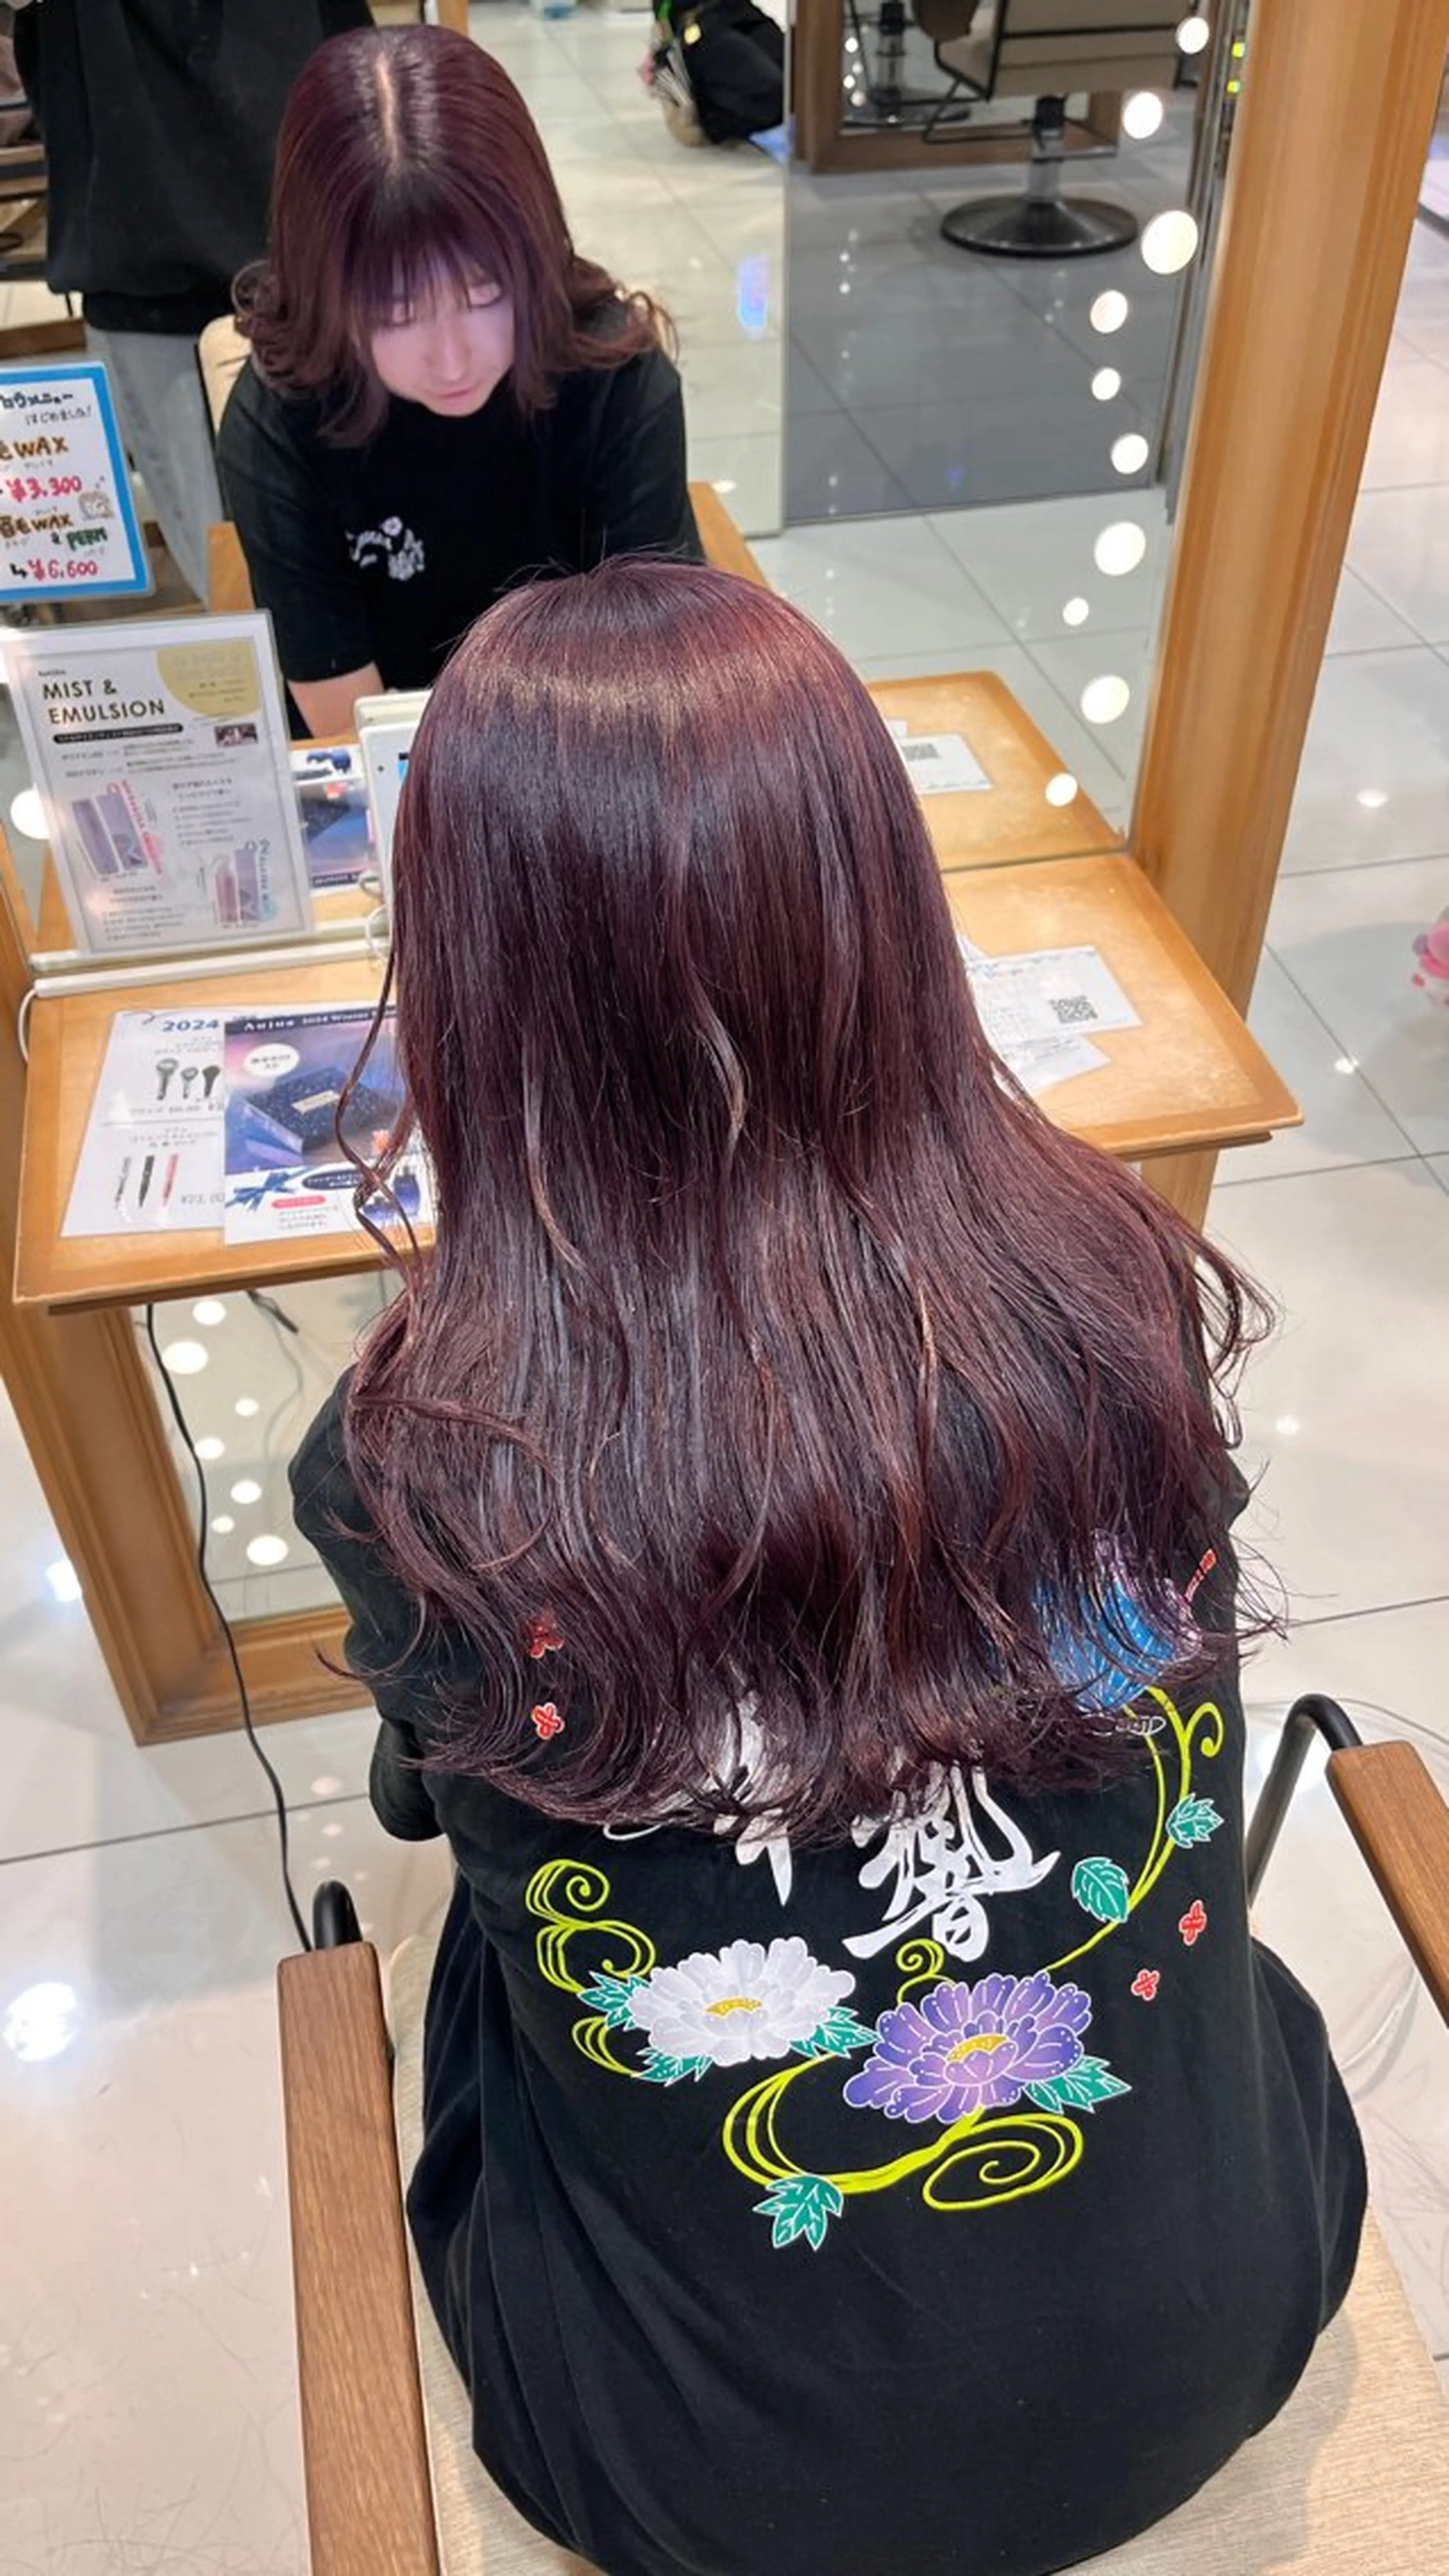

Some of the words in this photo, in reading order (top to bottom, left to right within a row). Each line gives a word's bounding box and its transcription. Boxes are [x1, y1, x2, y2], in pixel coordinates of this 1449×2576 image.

[43, 680, 92, 699] MIST
[103, 678, 116, 695] &
[48, 698, 165, 724] EMULSION
[162, 1019, 220, 1032] 2024
